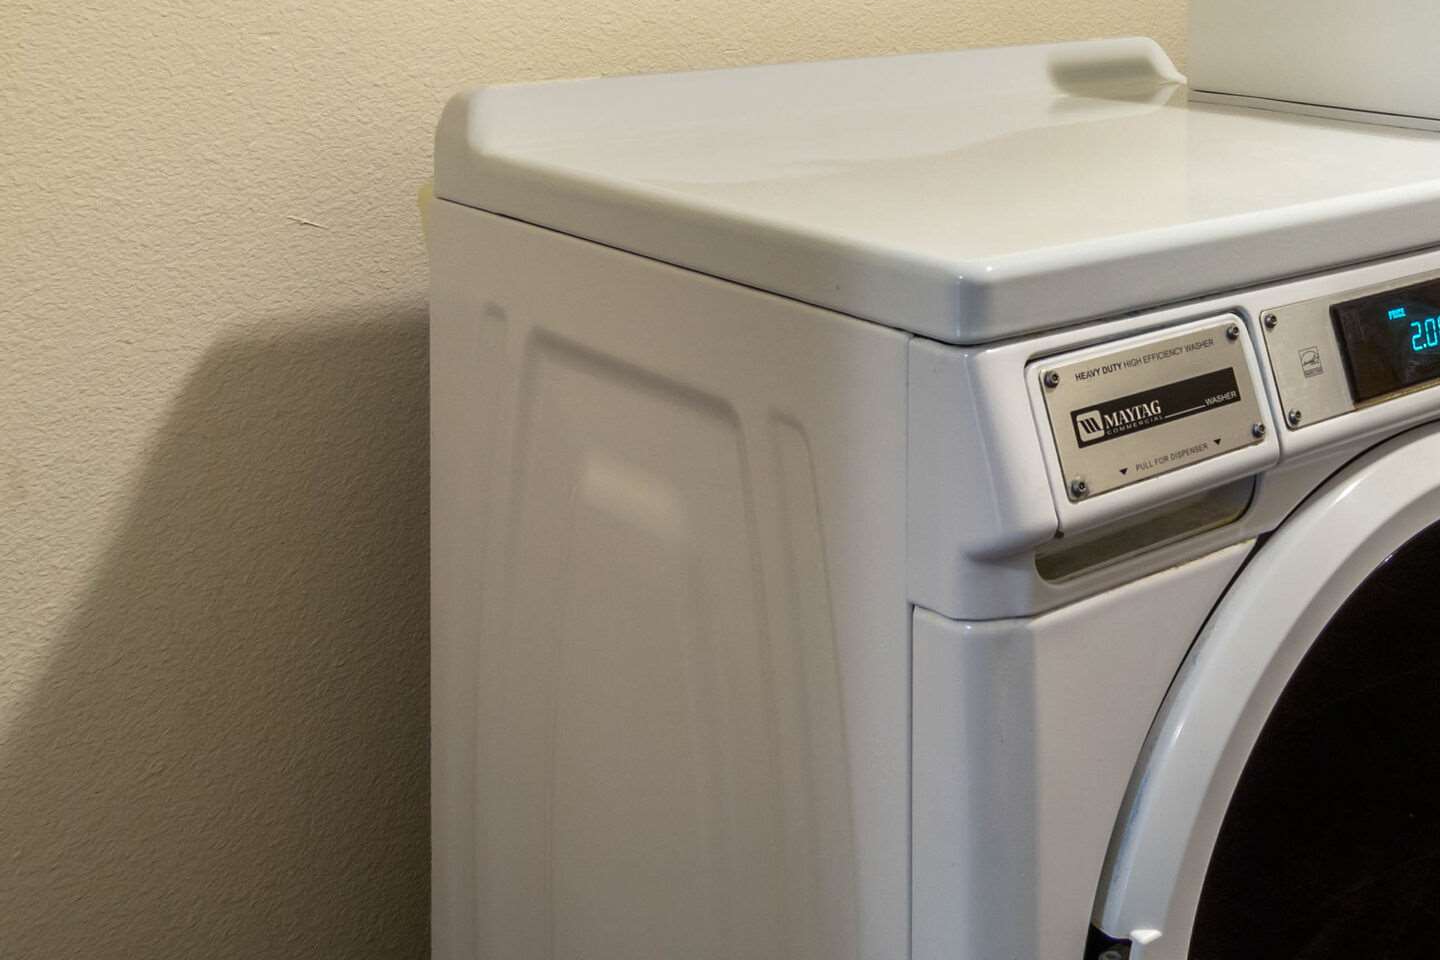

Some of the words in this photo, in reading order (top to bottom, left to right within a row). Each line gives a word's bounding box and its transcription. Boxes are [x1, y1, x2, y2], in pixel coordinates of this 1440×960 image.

[1075, 367, 1101, 382] HEAVY
[1102, 362, 1123, 374] DUTY
[1123, 357, 1143, 369] HIGH
[1143, 347, 1184, 364] EFFICIENCY
[1184, 338, 1214, 353] WASHER
[1204, 390, 1237, 407] WASHER
[1103, 399, 1162, 428] MAYTAG
[1106, 415, 1164, 436] COMMERCIAL
[1136, 460, 1153, 472] PULL
[1154, 455, 1169, 466] FOR
[1171, 443, 1208, 461] DISPENSER
